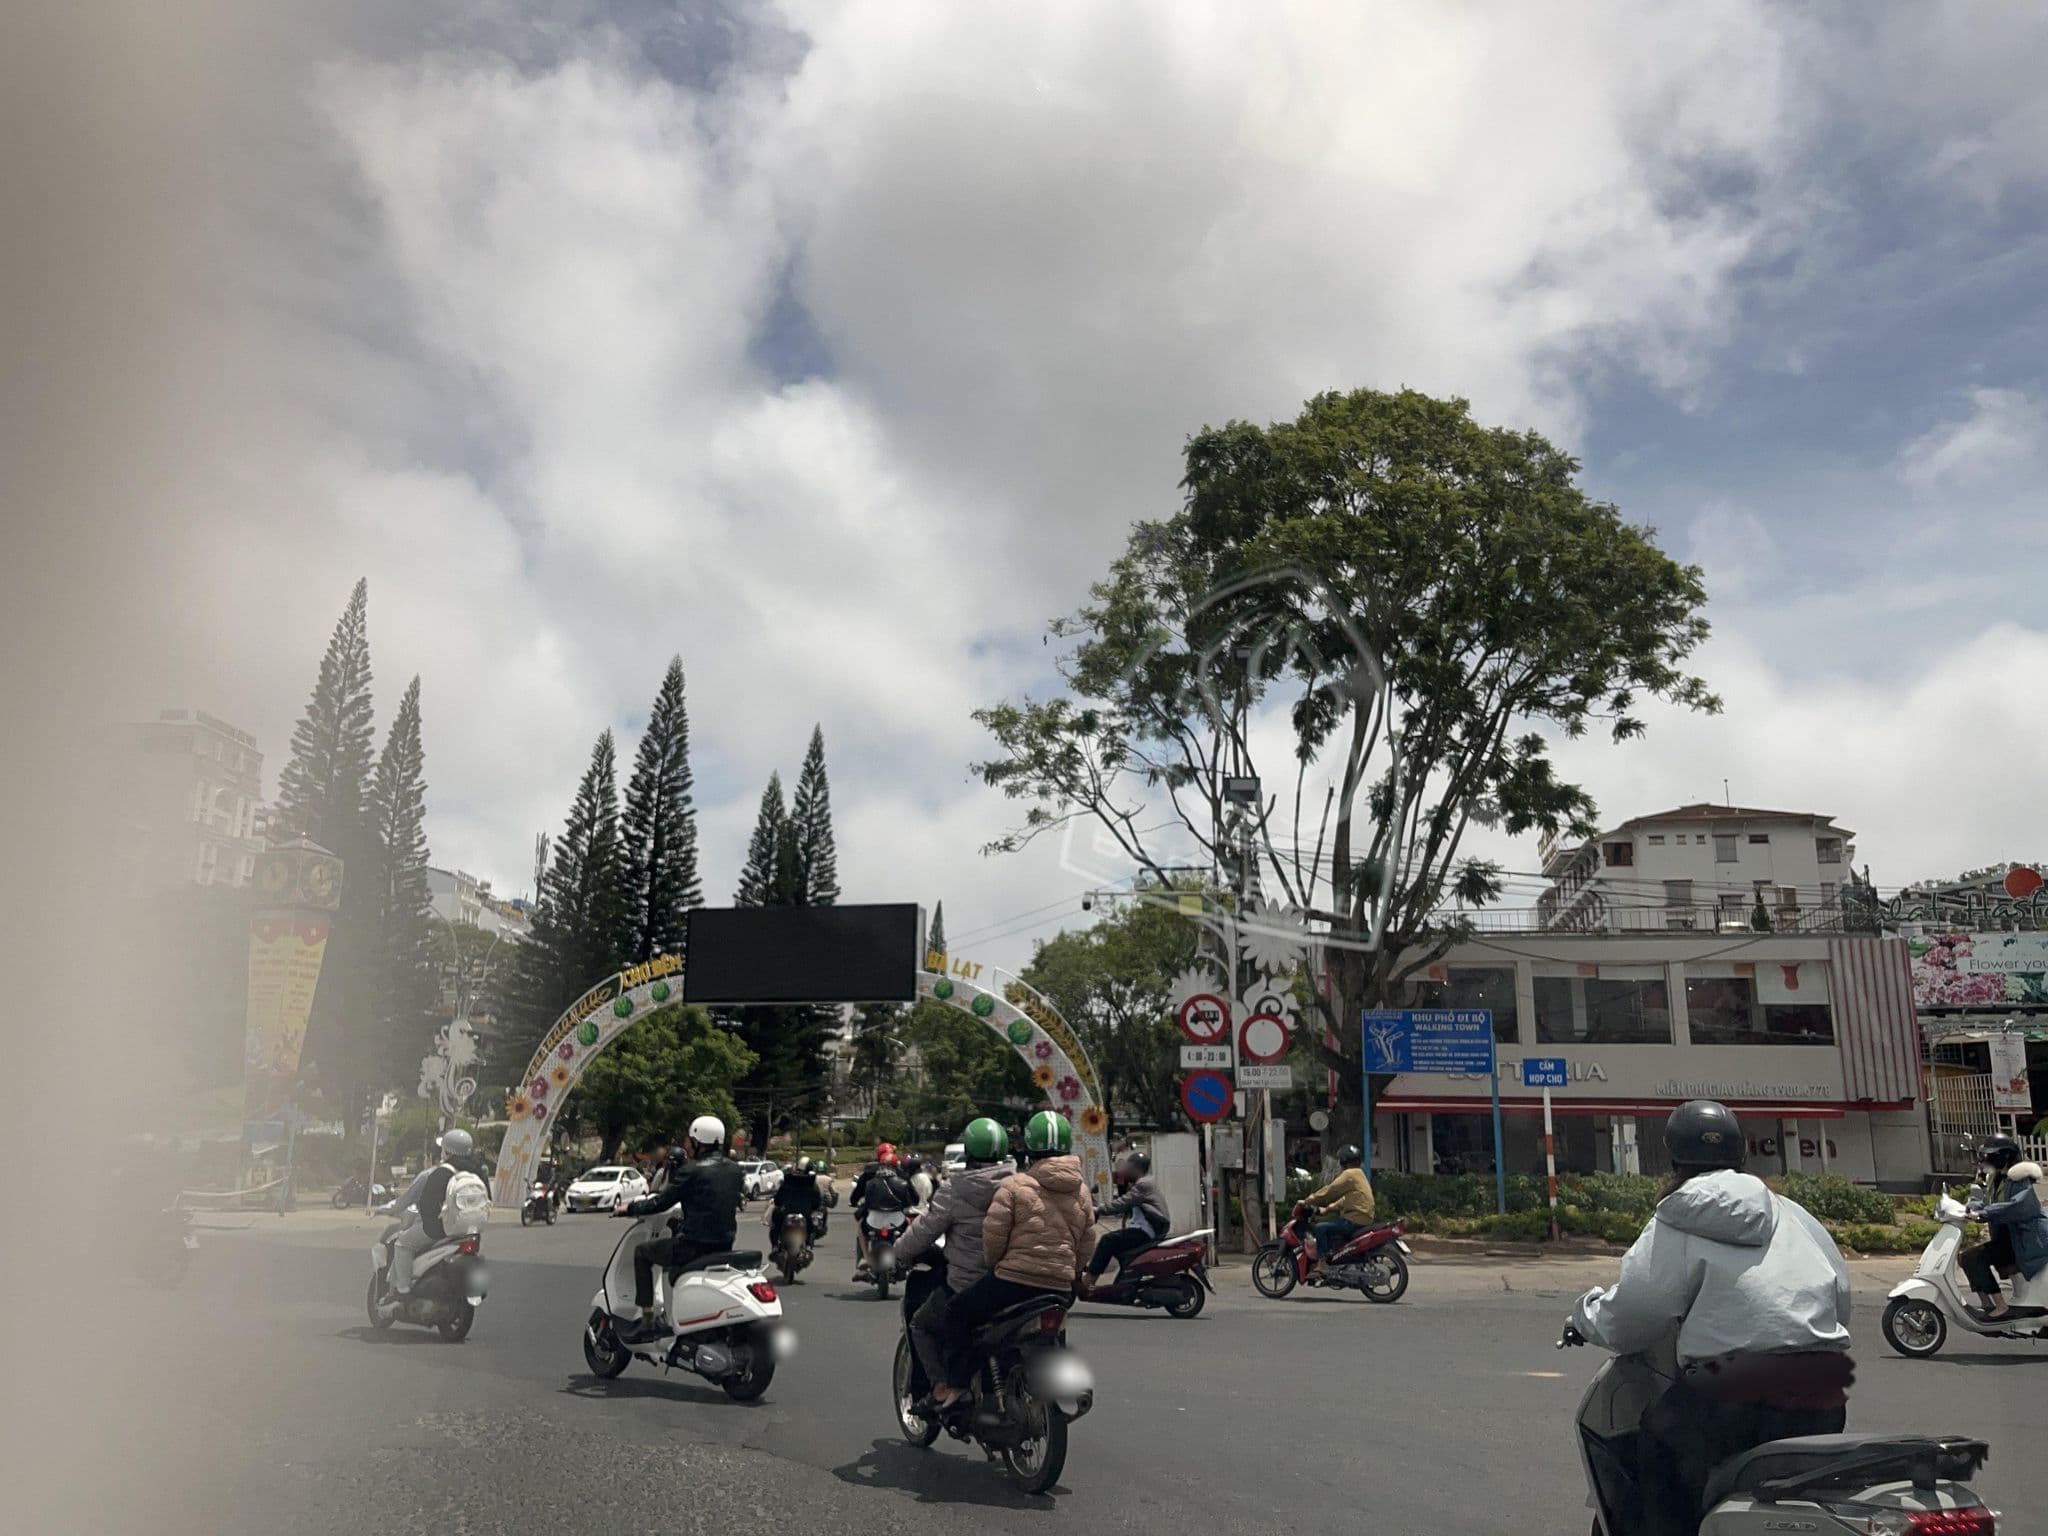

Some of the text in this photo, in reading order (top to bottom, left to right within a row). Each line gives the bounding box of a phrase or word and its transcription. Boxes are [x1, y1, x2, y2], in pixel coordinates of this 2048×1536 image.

[1963, 887, 2048, 929] Hasf
[1969, 959, 2018, 970] Flower
[1411, 1012, 1432, 1023] KHU
[1434, 1009, 1455, 1023] PHỐ
[1471, 1011, 1486, 1025] BỘ
[1414, 1023, 1480, 1031] WALKING TOWN
